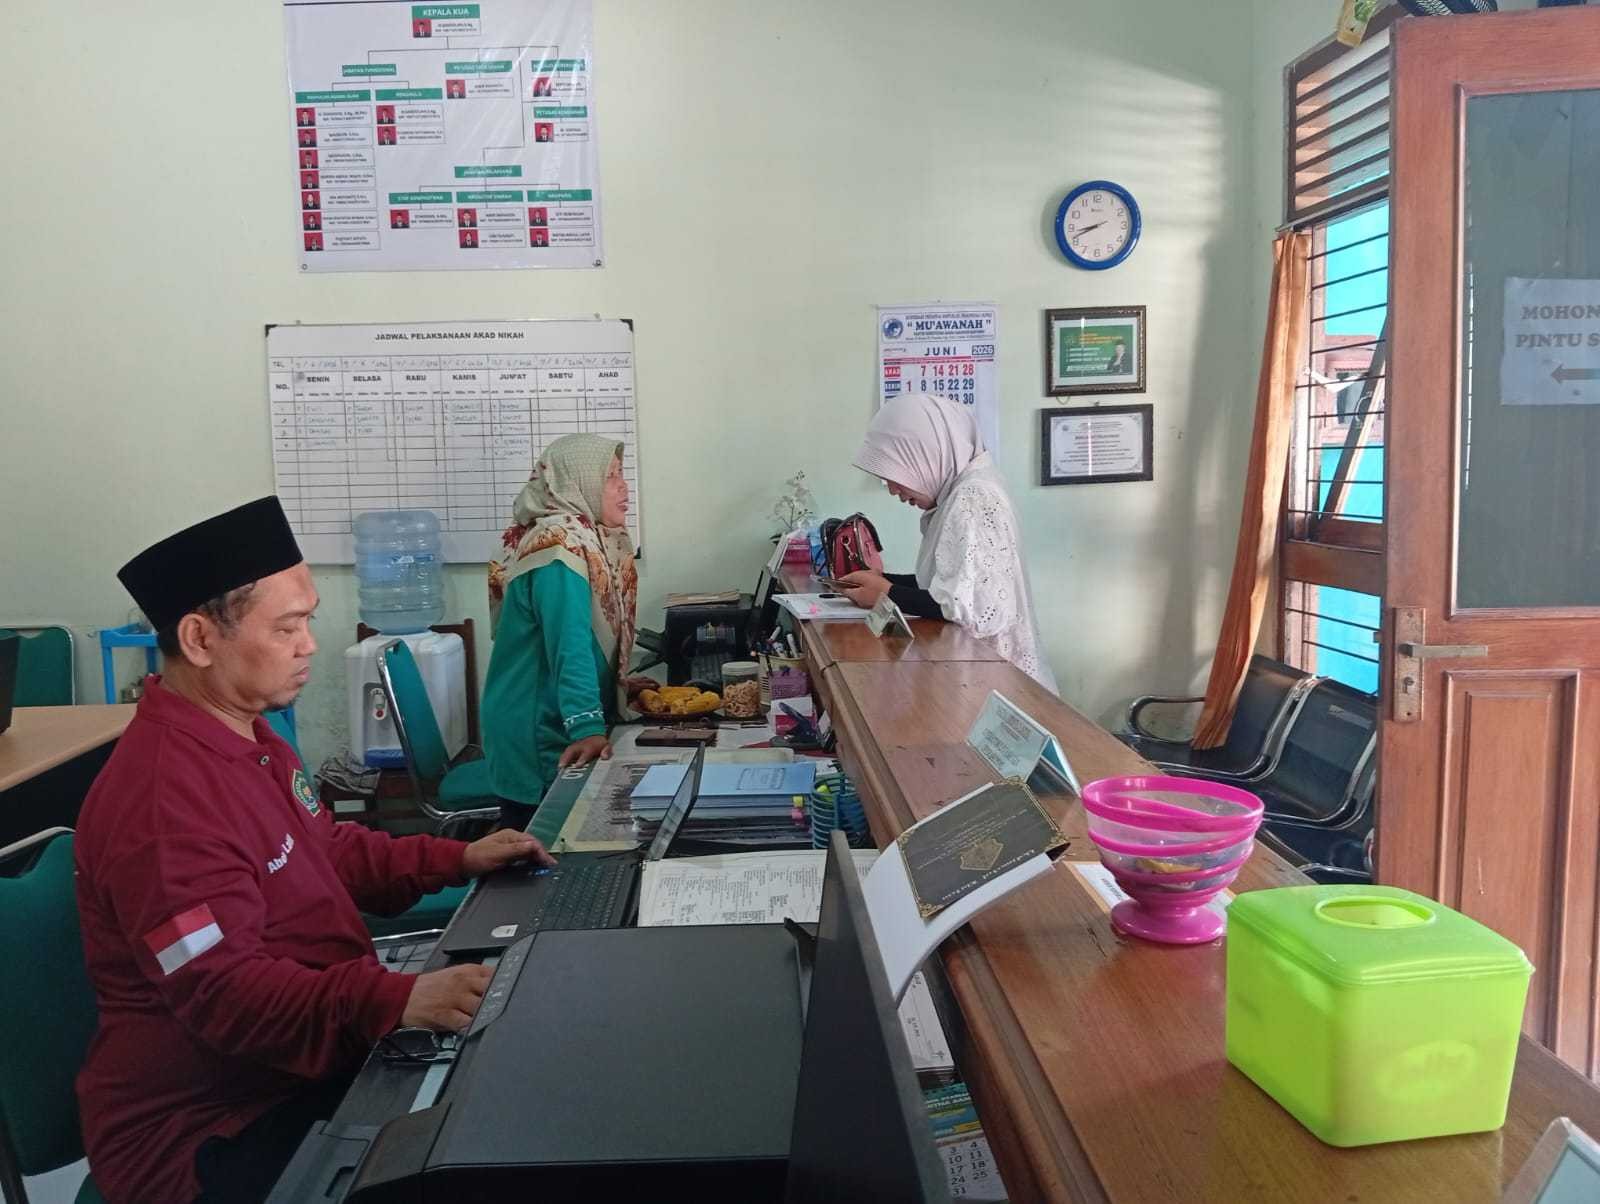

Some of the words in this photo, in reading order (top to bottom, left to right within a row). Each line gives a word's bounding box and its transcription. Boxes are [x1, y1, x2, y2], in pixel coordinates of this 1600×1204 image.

[423, 8, 452, 16] KEPALA
[453, 7, 470, 15] KUA
[1093, 194, 1103, 204] 12
[1071, 210, 1081, 219] 10
[1117, 208, 1124, 217] 2
[1068, 223, 1075, 232] 9
[1120, 221, 1128, 230] 3
[1080, 245, 1089, 254] 7
[1093, 248, 1101, 257] 6
[1106, 243, 1114, 253] 5
[1520, 304, 1600, 320] MOHON
[915, 320, 984, 330] MU'AWANAH
[375, 333, 409, 341] JADWAL
[411, 332, 471, 341] PELAKSANAAN
[498, 331, 525, 339] NIKAH
[1515, 333, 1582, 348] PINTU
[924, 347, 957, 356] JUNI
[920, 365, 927, 377] 7
[934, 365, 945, 377] 14
[948, 364, 959, 376] 21
[962, 364, 974, 376] 28
[906, 380, 912, 392] 1
[920, 379, 927, 392] 8
[934, 379, 945, 391] 15
[947, 379, 960, 391] 22
[962, 378, 974, 390] 29
[962, 393, 975, 405] 30
[949, 1155, 963, 1165] 10
[950, 1165, 964, 1175] 17
[971, 1160, 986, 1170] 18
[951, 1175, 966, 1186] 24
[972, 1171, 988, 1181] 25
